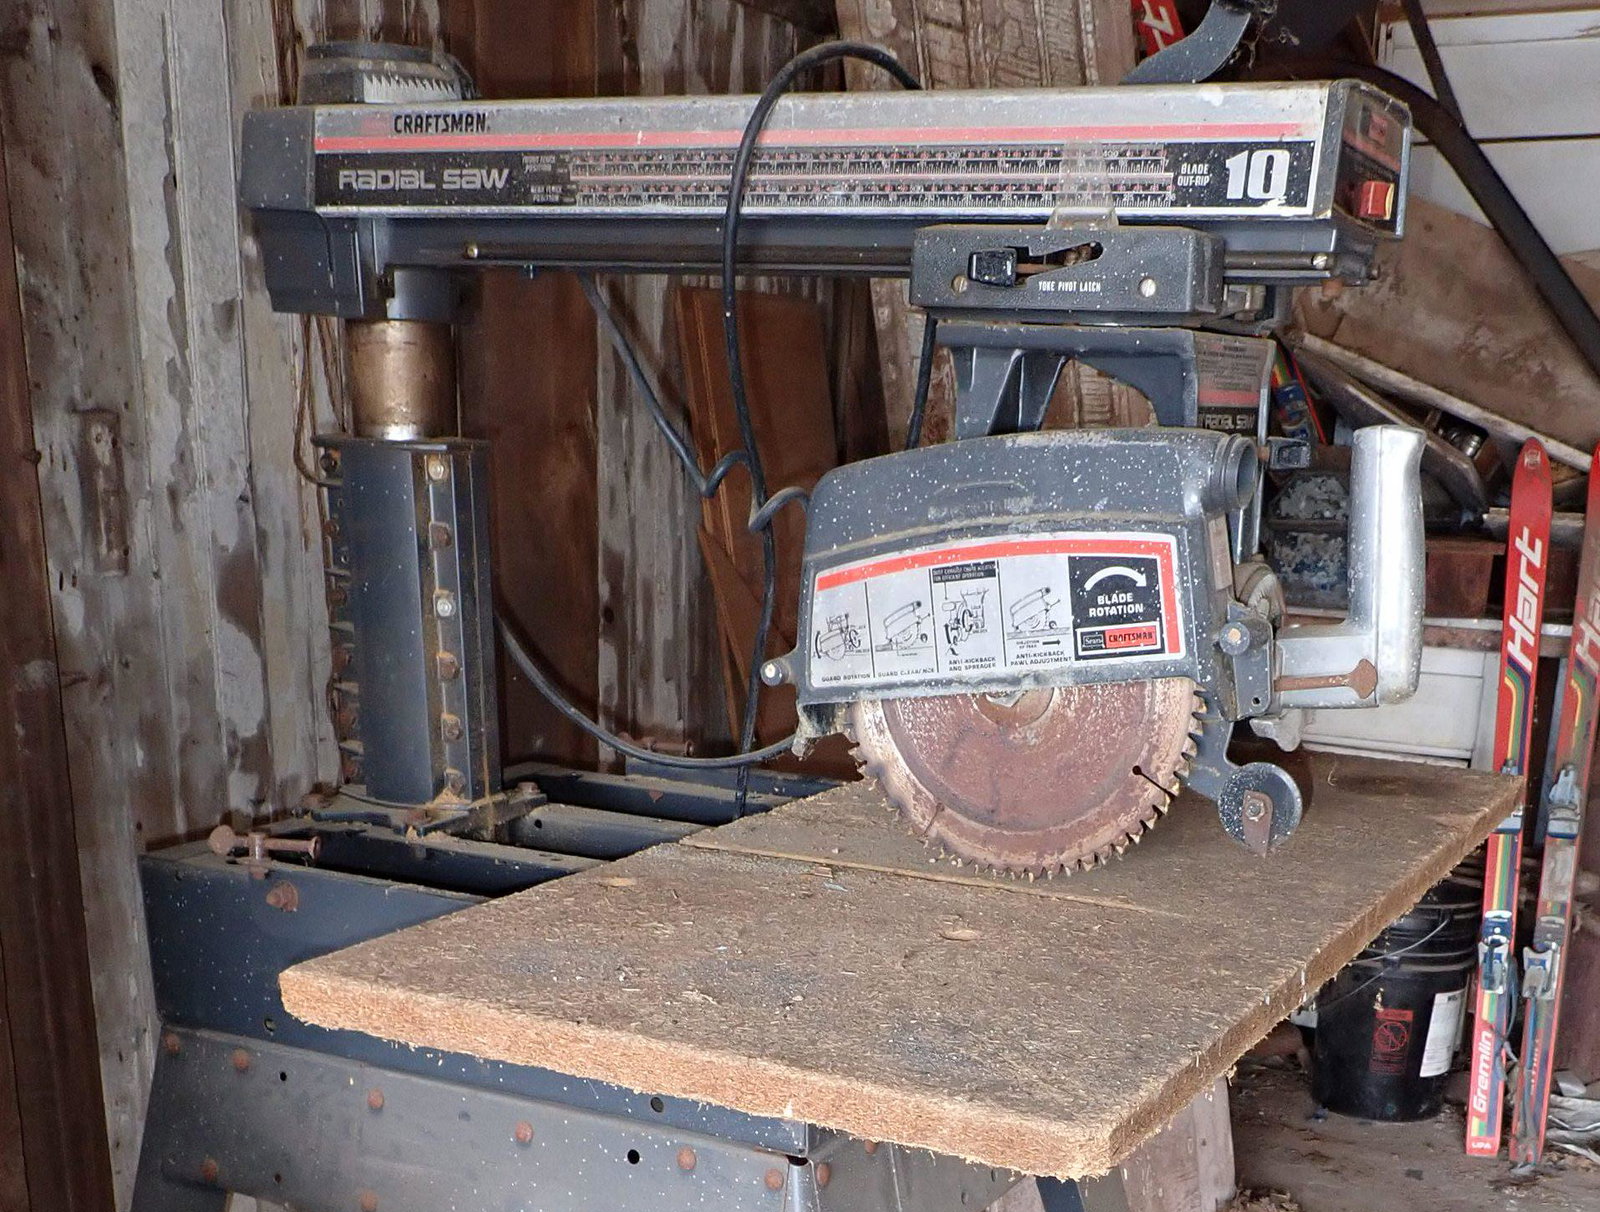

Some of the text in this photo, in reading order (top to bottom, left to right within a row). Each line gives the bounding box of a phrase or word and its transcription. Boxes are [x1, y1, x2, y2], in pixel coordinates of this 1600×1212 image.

[394, 113, 486, 134] CRAFTSMAN
[1181, 163, 1209, 175] BLADE
[1225, 149, 1290, 200] 10
[1177, 175, 1210, 186] OUT-RIP
[1038, 281, 1055, 292] YOKE
[1057, 281, 1077, 292] PIVOT
[1097, 592, 1134, 605] BLADE
[1507, 526, 1543, 672] Hart
[1088, 603, 1144, 617] ROTATION
[1473, 1030, 1492, 1113] Gremlin
